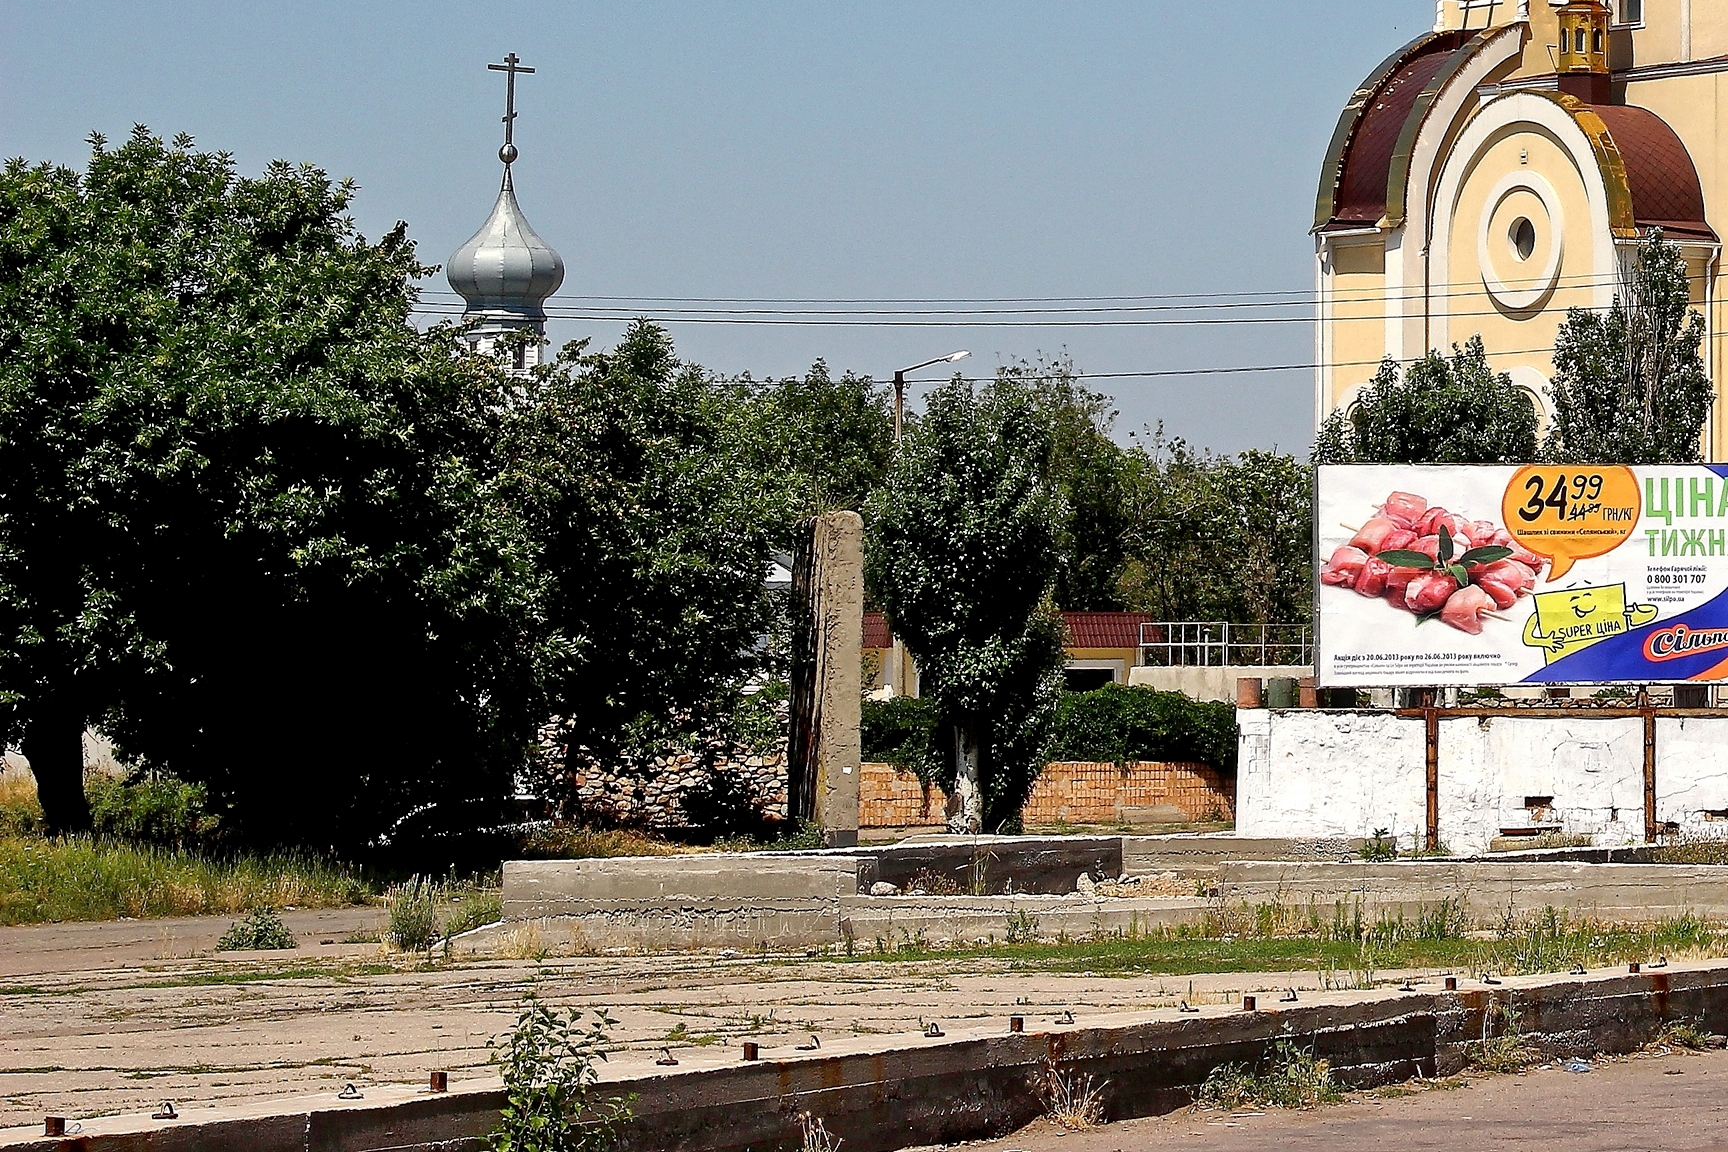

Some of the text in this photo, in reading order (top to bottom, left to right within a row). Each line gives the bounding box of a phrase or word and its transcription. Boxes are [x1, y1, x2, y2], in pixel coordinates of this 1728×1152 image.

[1602, 507, 1634, 521] ГРН/КГ
[1647, 574, 1706, 584] 0 800 301 707
[1558, 623, 1592, 638] SUPER
[1366, 653, 1399, 661] 20.06.2013
[1424, 652, 1457, 660] 26.06.2013
